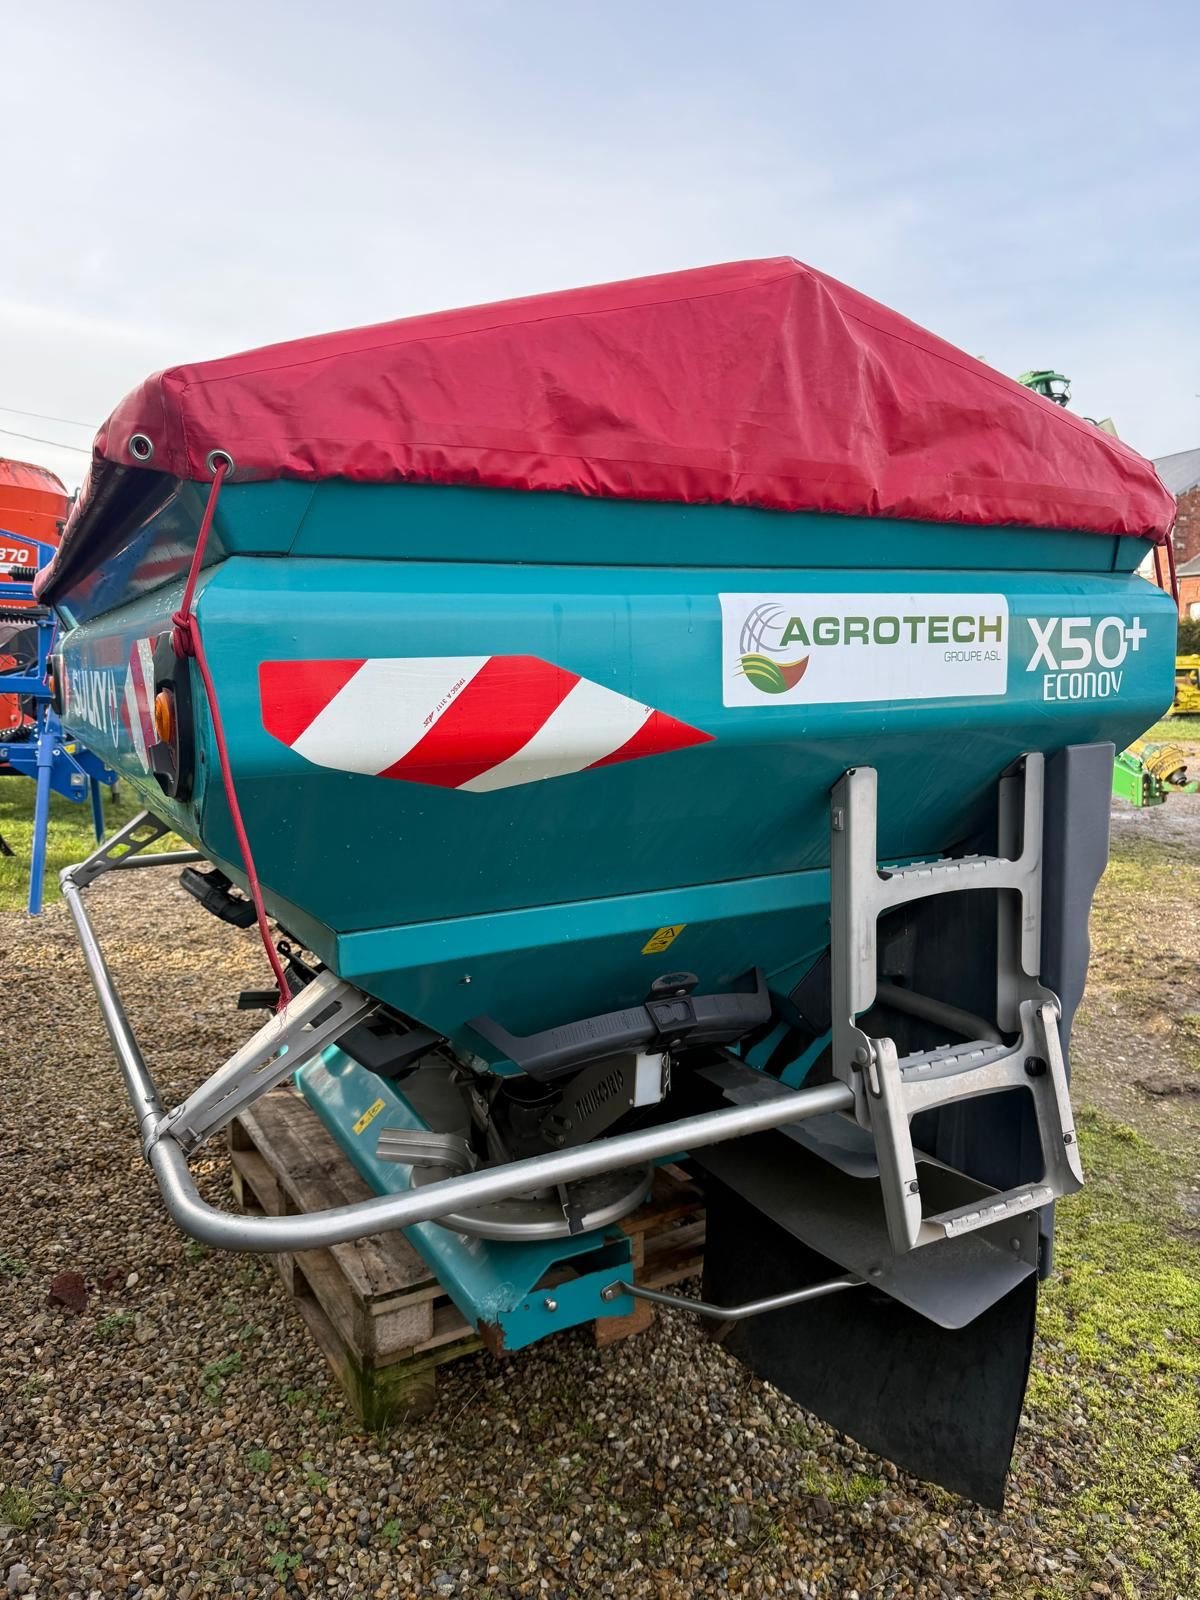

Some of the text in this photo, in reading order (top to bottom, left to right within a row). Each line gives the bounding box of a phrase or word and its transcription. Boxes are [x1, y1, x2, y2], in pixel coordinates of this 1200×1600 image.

[779, 615, 1002, 647] AGROTECH
[1026, 616, 1147, 672] X50+
[944, 650, 1001, 663] GROUPE ASL
[72, 670, 107, 734] SULKY
[1043, 671, 1123, 701] ECONOV
